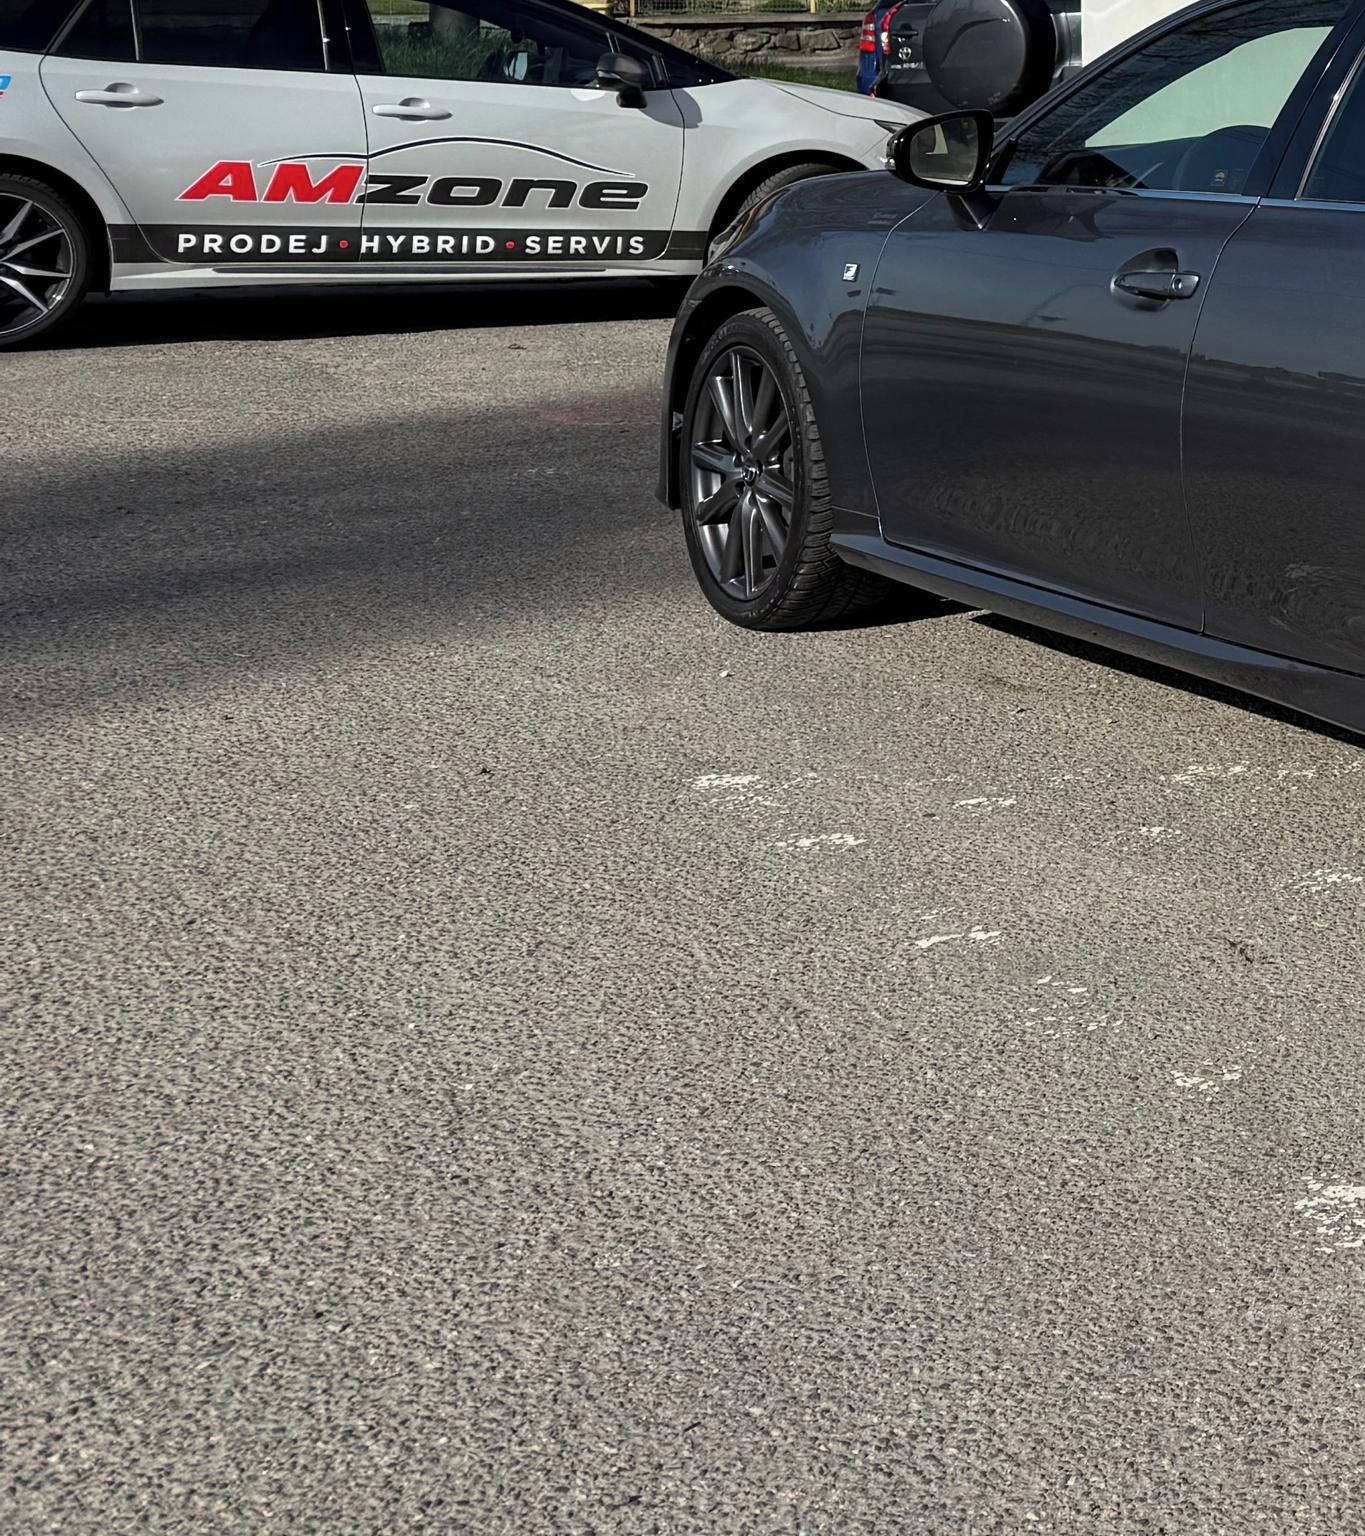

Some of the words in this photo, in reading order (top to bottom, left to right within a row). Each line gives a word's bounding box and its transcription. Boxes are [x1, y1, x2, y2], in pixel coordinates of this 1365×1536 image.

[175, 160, 650, 212] AMzone
[177, 232, 328, 255] PRODEJ
[361, 233, 496, 255] HYBRID
[524, 234, 645, 256] SERVIS
